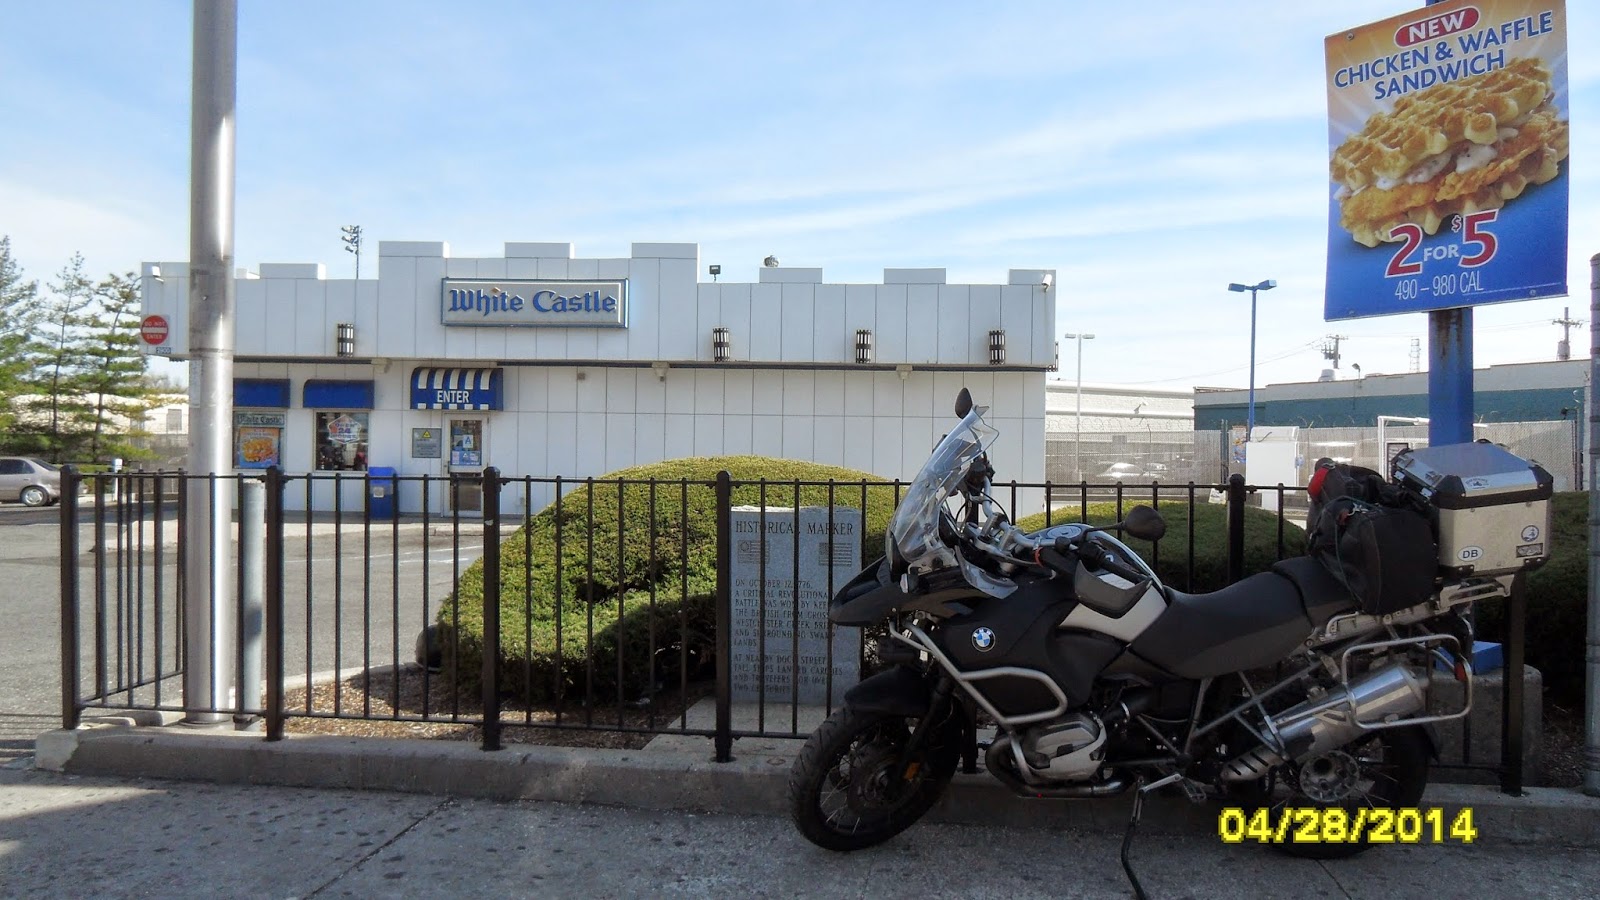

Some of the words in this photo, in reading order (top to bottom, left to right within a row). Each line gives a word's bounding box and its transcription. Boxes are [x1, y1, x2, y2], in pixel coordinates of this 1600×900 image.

[1408, 10, 1466, 43] NEW
[1334, 46, 1430, 89] CHICKEN
[1434, 41, 1454, 61] &
[1460, 11, 1554, 53] WAFFLE
[1374, 50, 1505, 100] SANDWICH
[1384, 223, 1424, 279] 2
[1423, 243, 1460, 262] FOR
[447, 285, 526, 317] White
[532, 289, 618, 314] Castle
[1394, 279, 1418, 302] 490
[1431, 274, 1457, 298] 980
[1459, 271, 1484, 295] CAL
[437, 390, 470, 404] ENTER
[736, 520, 800, 535] HISTRICA
[1462, 549, 1479, 560] DB
[743, 590, 775, 598] CRITAL
[735, 608, 748, 617] THE
